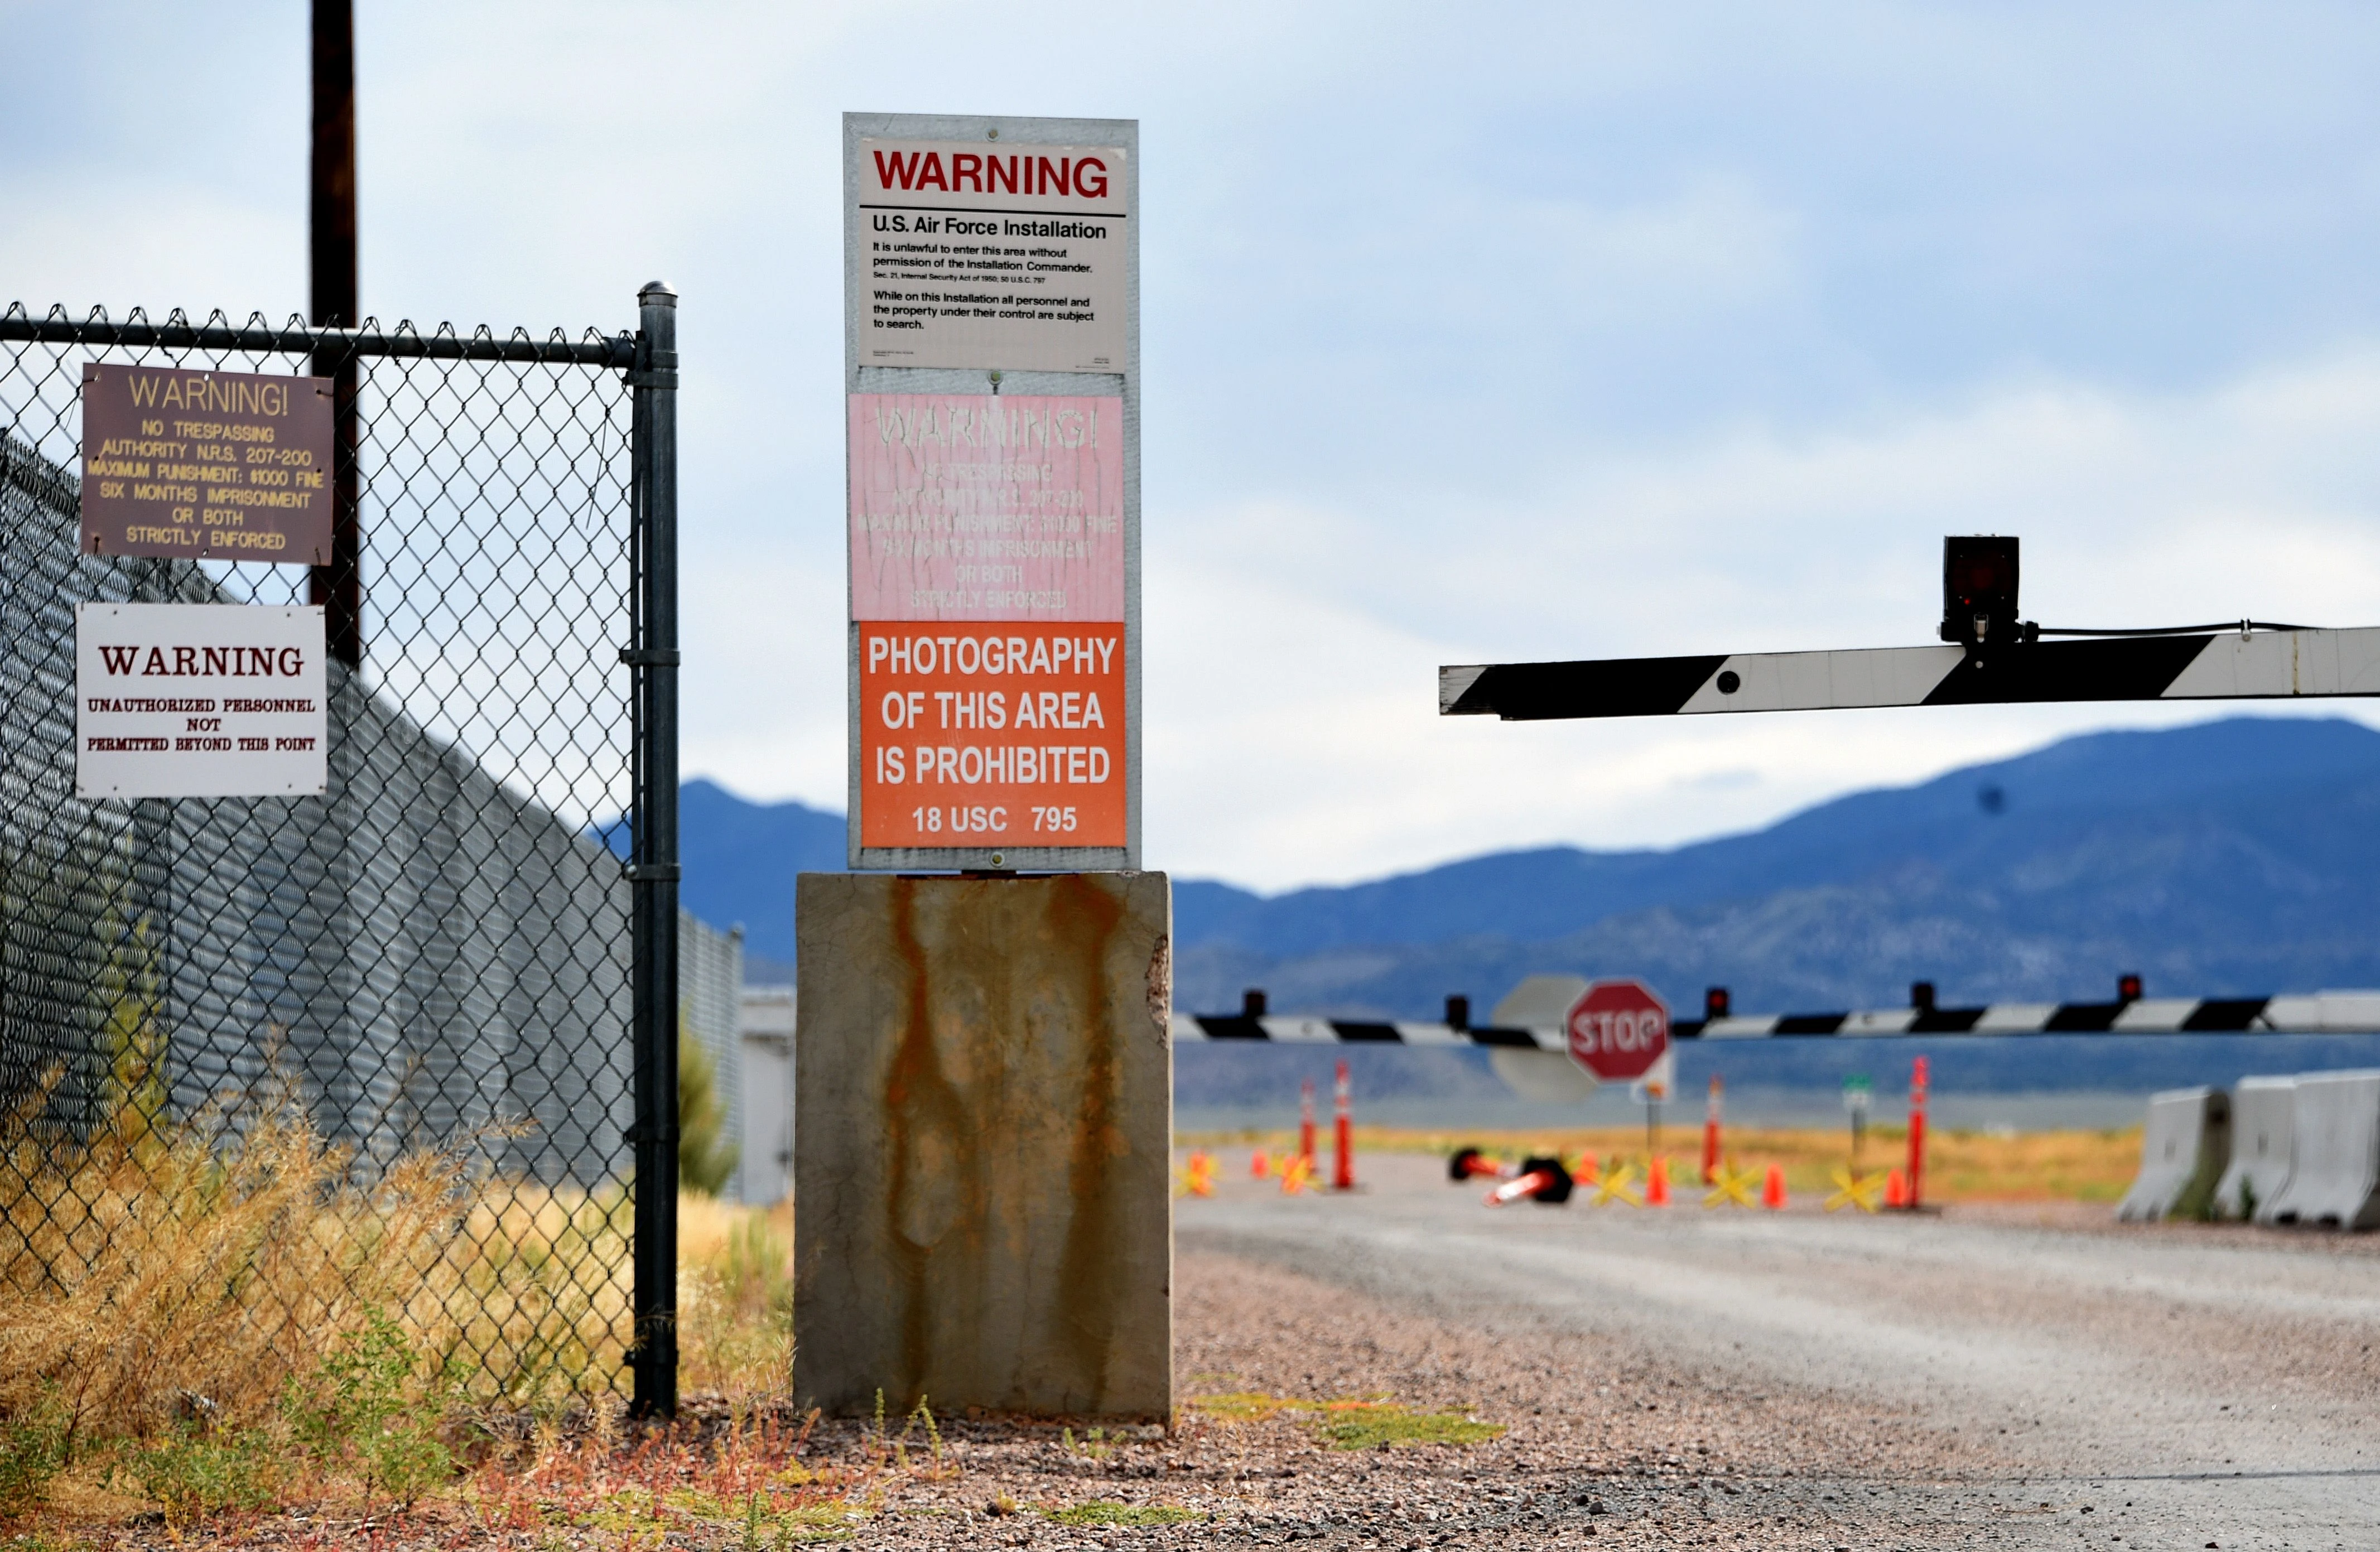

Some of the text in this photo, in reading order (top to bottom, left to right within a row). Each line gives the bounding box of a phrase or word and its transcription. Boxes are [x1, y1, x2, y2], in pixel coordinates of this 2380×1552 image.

[874, 151, 1108, 198] WARNING
[873, 215, 1106, 239] U.S. Air Force Installation
[873, 243, 1067, 258] It is unlawful to enter this area without
[873, 258, 1092, 273] permission of the Installation Commander.
[874, 291, 1089, 308] While on this Installation all personnel and
[874, 305, 1094, 322] the property under their control are subject
[874, 320, 924, 330] to search.
[129, 375, 288, 417] WARNING!
[142, 420, 274, 442] NO TRESPASSING
[875, 407, 1098, 449] WARNING!
[100, 439, 312, 466] AUTHORITY N.R.S. 207-200
[88, 459, 324, 489] MAXIMUM PUNISHMENT: $1000 FINE
[100, 483, 312, 509] SIX MONTHS IMPRISONMENT
[172, 507, 243, 526] OR BOTH
[126, 527, 286, 550] STRICTLY ENFORCED
[982, 565, 1023, 583] BOTH
[99, 646, 305, 677] WARNING
[869, 637, 1116, 674] PHOTOGRAPHY
[88, 698, 315, 713] UNAUTHORIZED PERSONNEL
[881, 691, 1105, 729] OF THIS AREA
[187, 719, 221, 731] NOT
[87, 738, 315, 751] PERMITTED BEYOND THIS POINT
[876, 746, 1110, 784] IS PROHIBITED
[913, 807, 1077, 832] 18 USC 795
[1573, 1010, 1663, 1054] STOP
